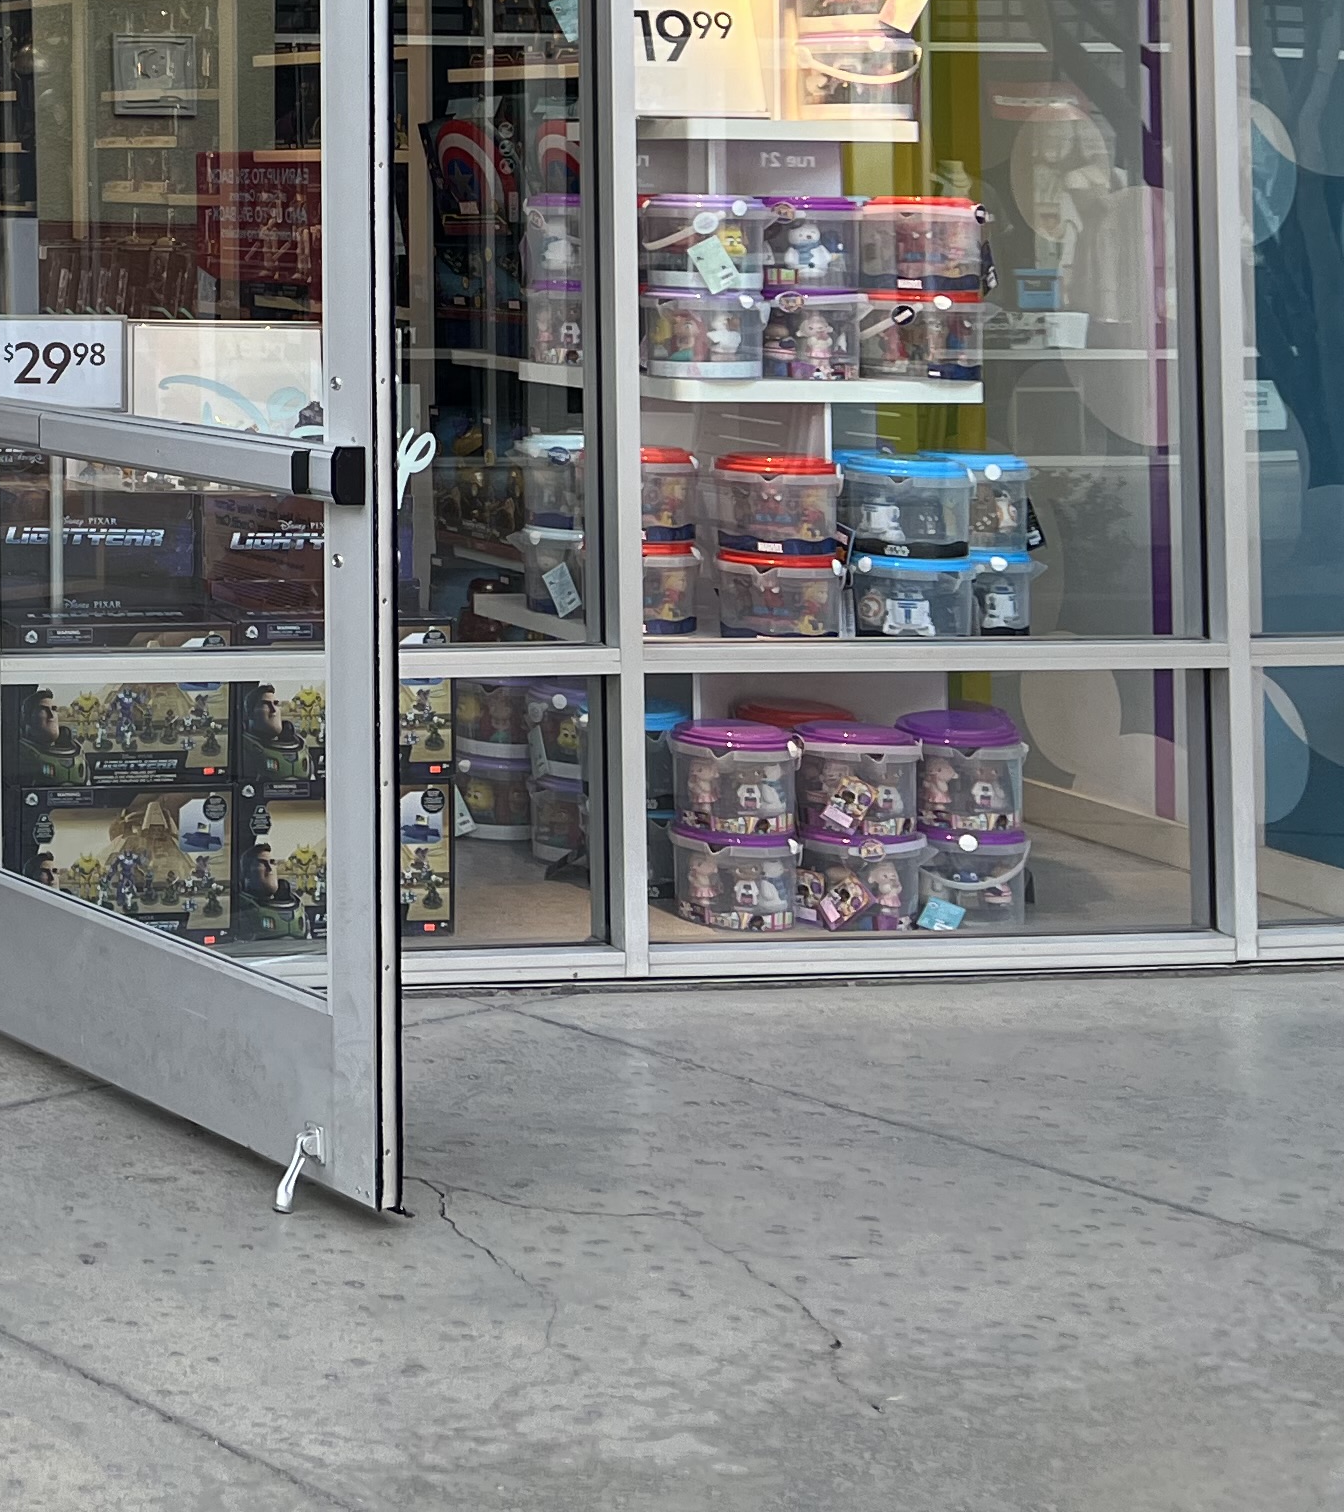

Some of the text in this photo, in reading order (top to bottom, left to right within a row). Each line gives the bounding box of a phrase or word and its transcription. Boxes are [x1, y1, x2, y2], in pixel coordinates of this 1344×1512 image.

[88, 516, 117, 526] PIXAR
[278, 518, 306, 532] Disney
[93, 600, 122, 609] PIXAR
